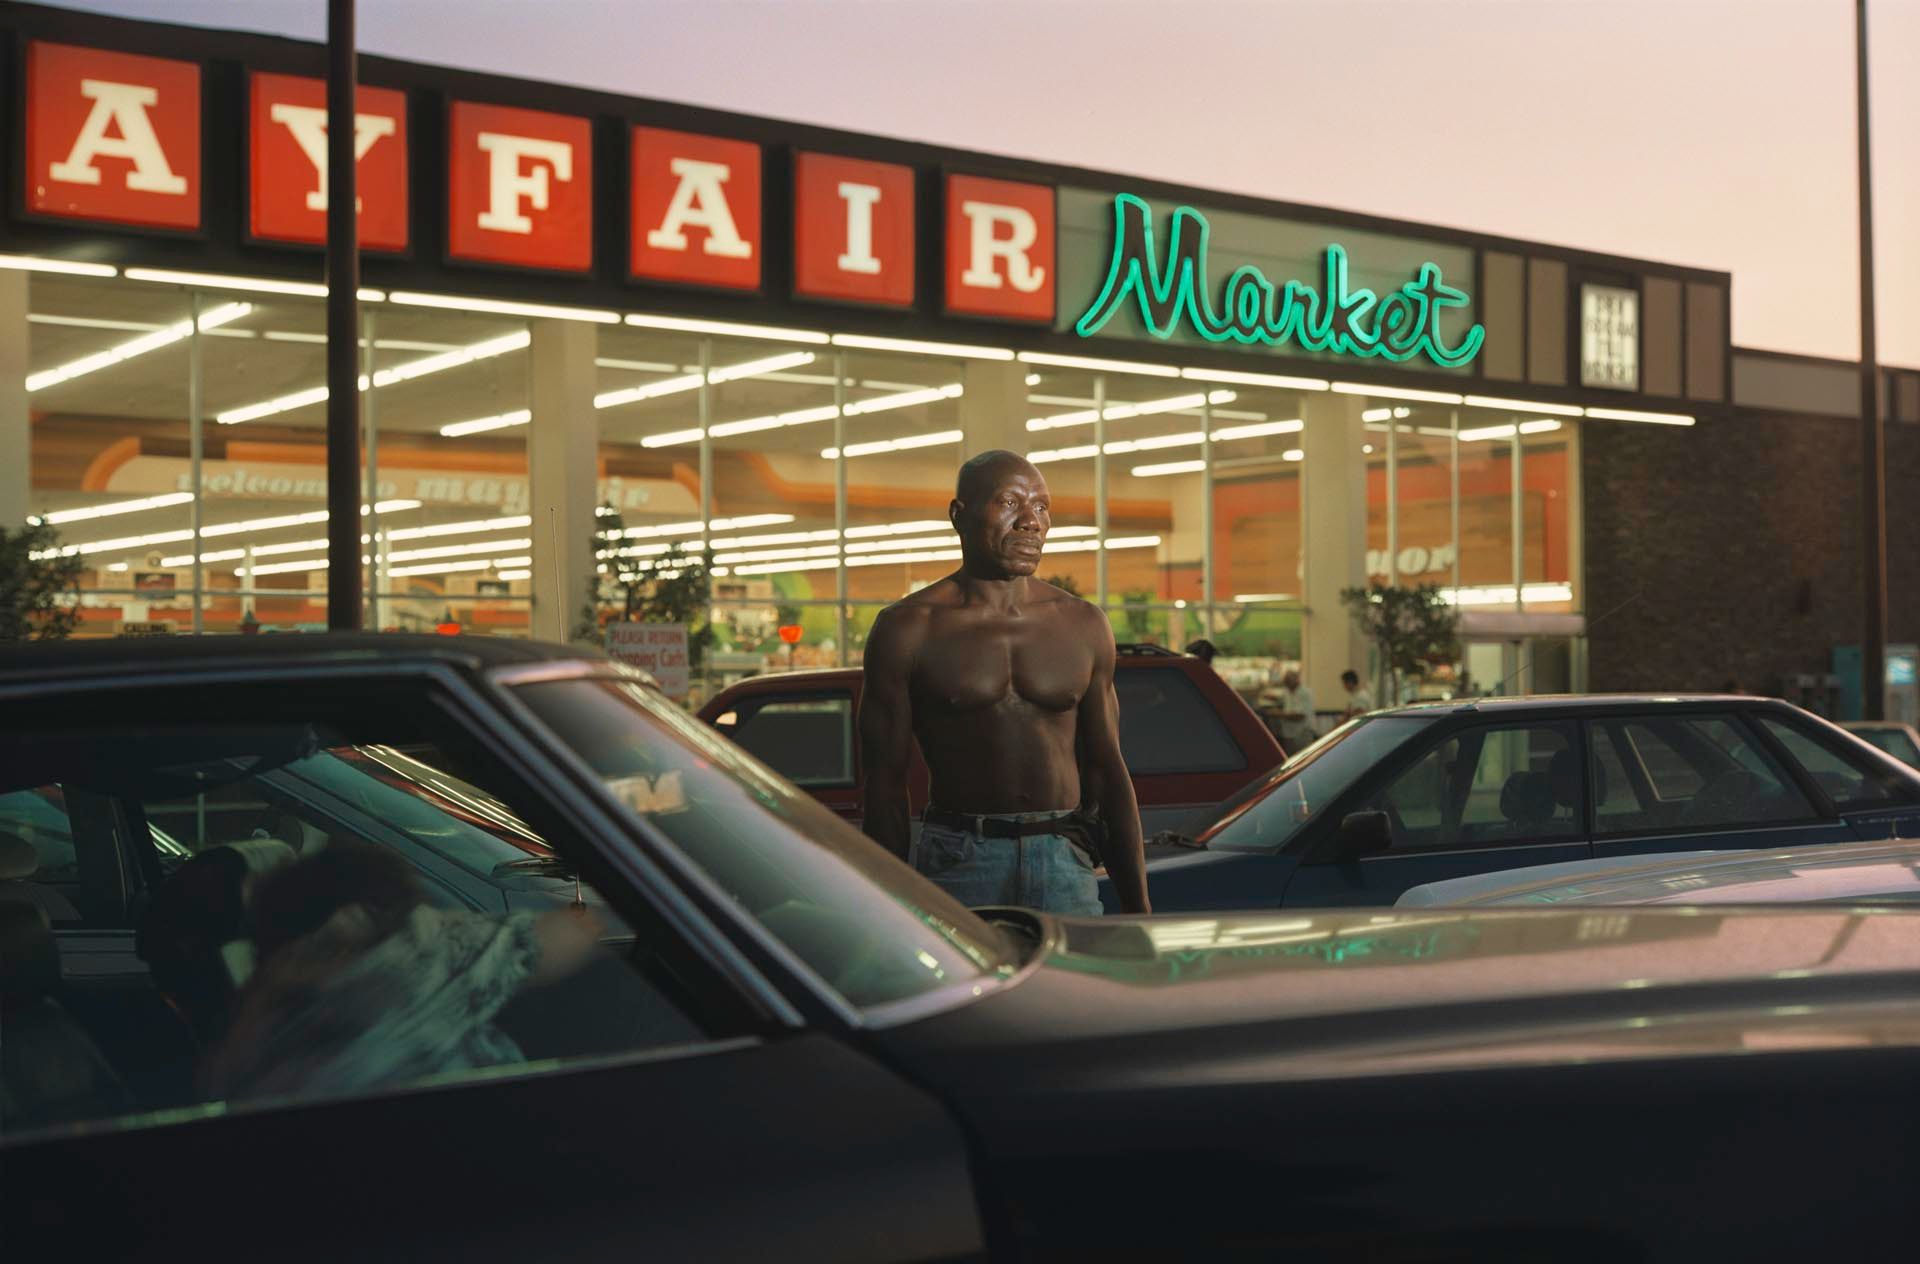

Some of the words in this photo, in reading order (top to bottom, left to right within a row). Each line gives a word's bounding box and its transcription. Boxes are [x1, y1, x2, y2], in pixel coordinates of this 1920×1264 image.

[1076, 192, 1485, 368] Market
[176, 468, 329, 497] welcom
[415, 476, 649, 515] mayir
